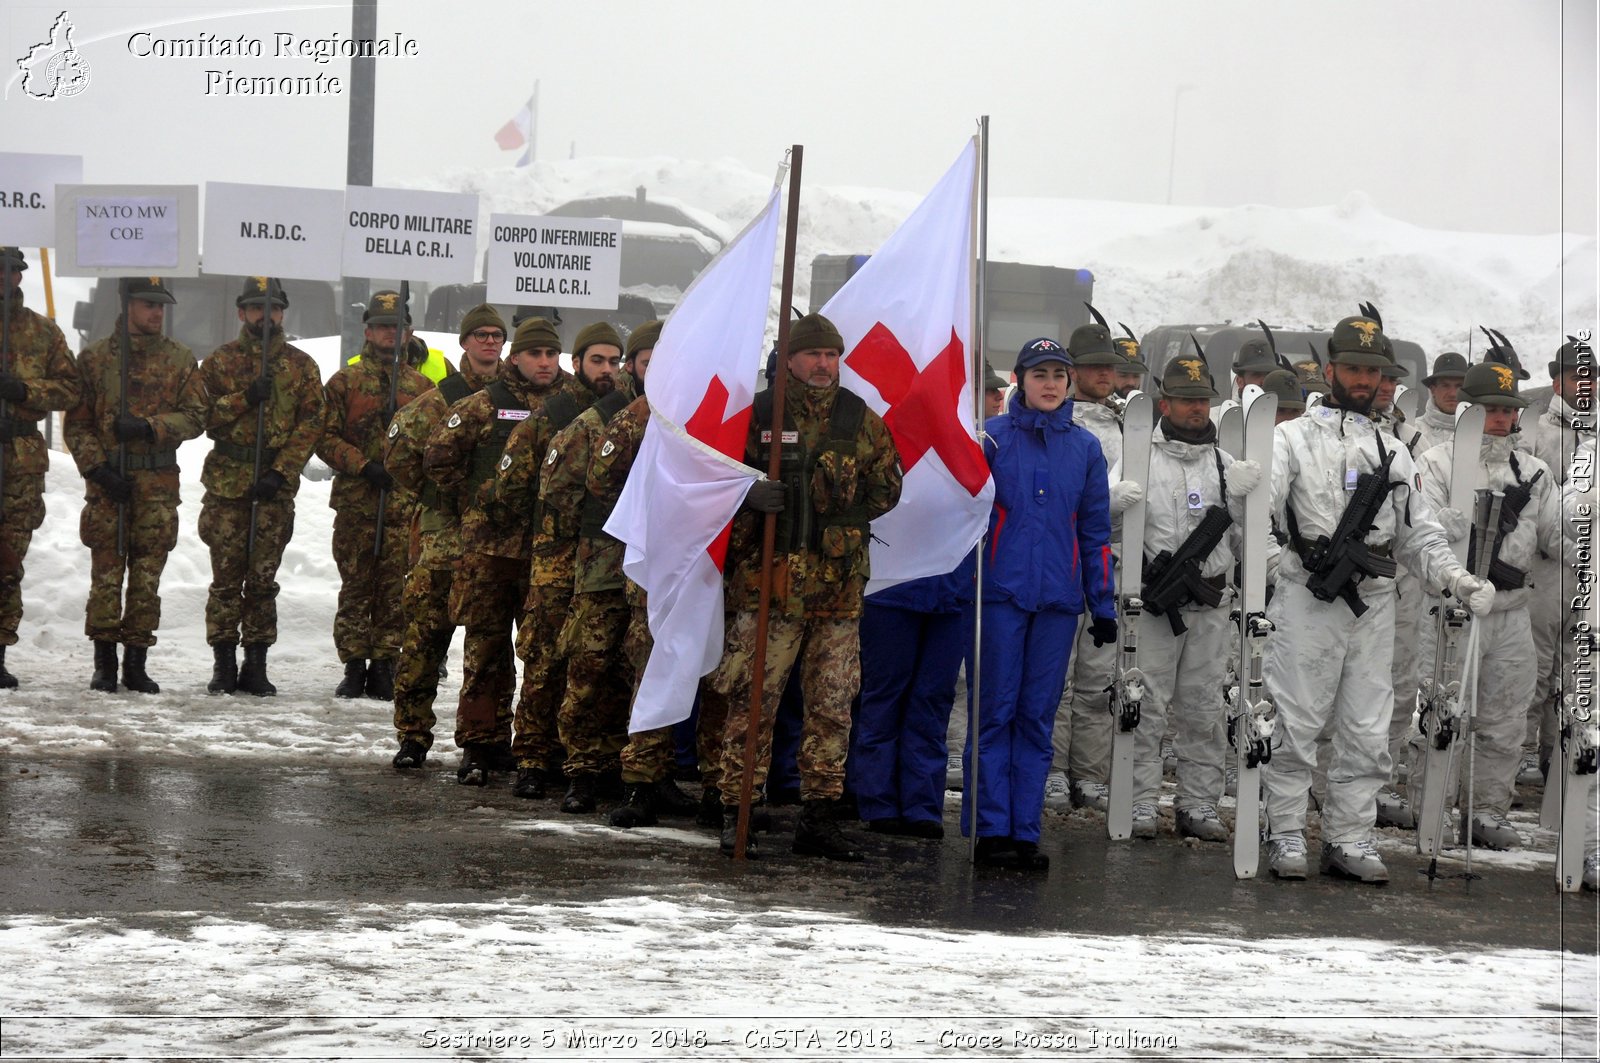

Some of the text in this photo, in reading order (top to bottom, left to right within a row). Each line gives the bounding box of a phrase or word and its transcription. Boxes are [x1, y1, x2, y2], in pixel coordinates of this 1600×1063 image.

[86, 205, 168, 219] NATO MW
[240, 222, 306, 241] N.R.D.C.
[349, 211, 472, 234] CORPO MILITARE
[110, 227, 144, 240] COE
[494, 226, 617, 248] CORPO INFERMIERE
[365, 237, 454, 259] DELLA C.R.I.
[514, 252, 591, 271] VOLONTARIE
[515, 277, 591, 295] DELLA C.R.I.
